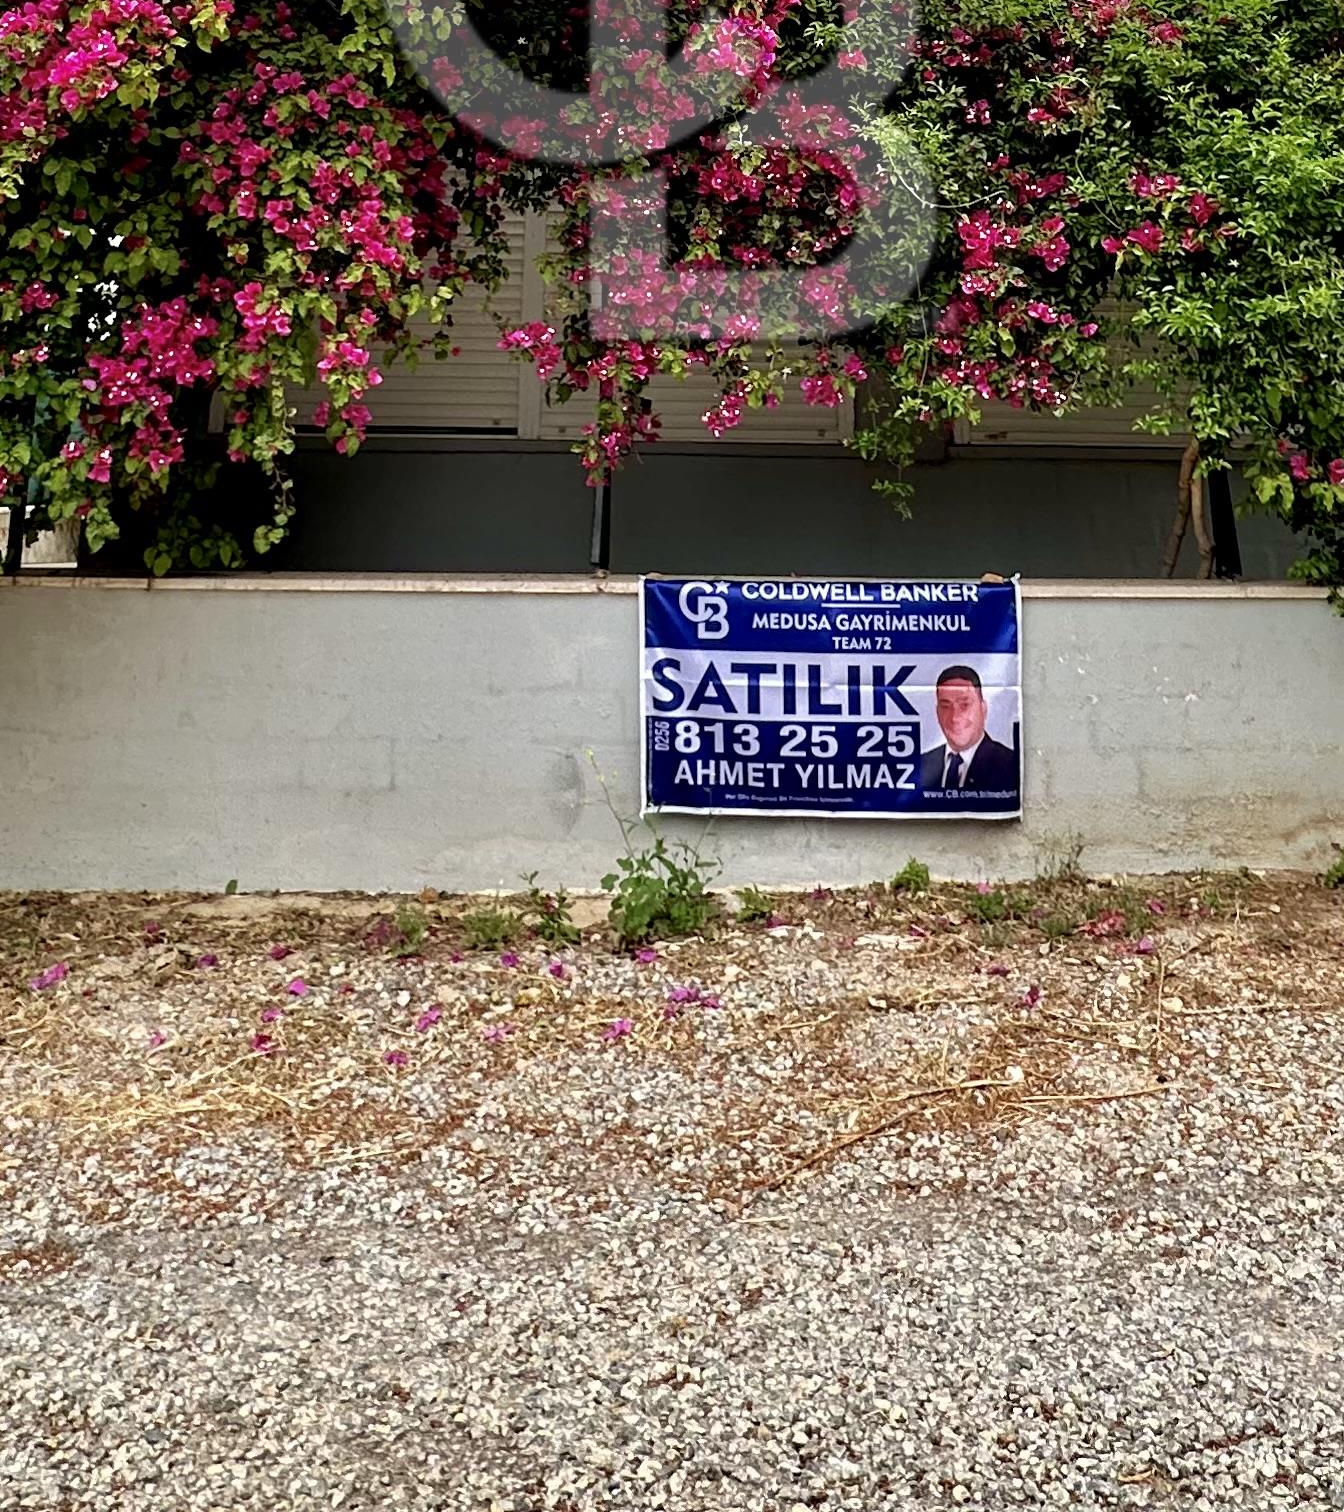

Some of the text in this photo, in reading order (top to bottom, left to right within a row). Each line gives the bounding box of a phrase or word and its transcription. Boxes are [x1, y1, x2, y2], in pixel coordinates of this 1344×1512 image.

[741, 582, 979, 602] COLDWELL BANKER
[679, 580, 729, 640] CB
[751, 610, 971, 631] MEDUSA GAYRİMENKUL
[832, 637, 892, 650] TEAM 72
[652, 657, 920, 716] SATILIK
[654, 720, 671, 752] 0256
[674, 720, 760, 756] 813
[779, 725, 838, 758] 25
[856, 725, 915, 758] 25
[674, 759, 916, 790] AHMET YILMAZ
